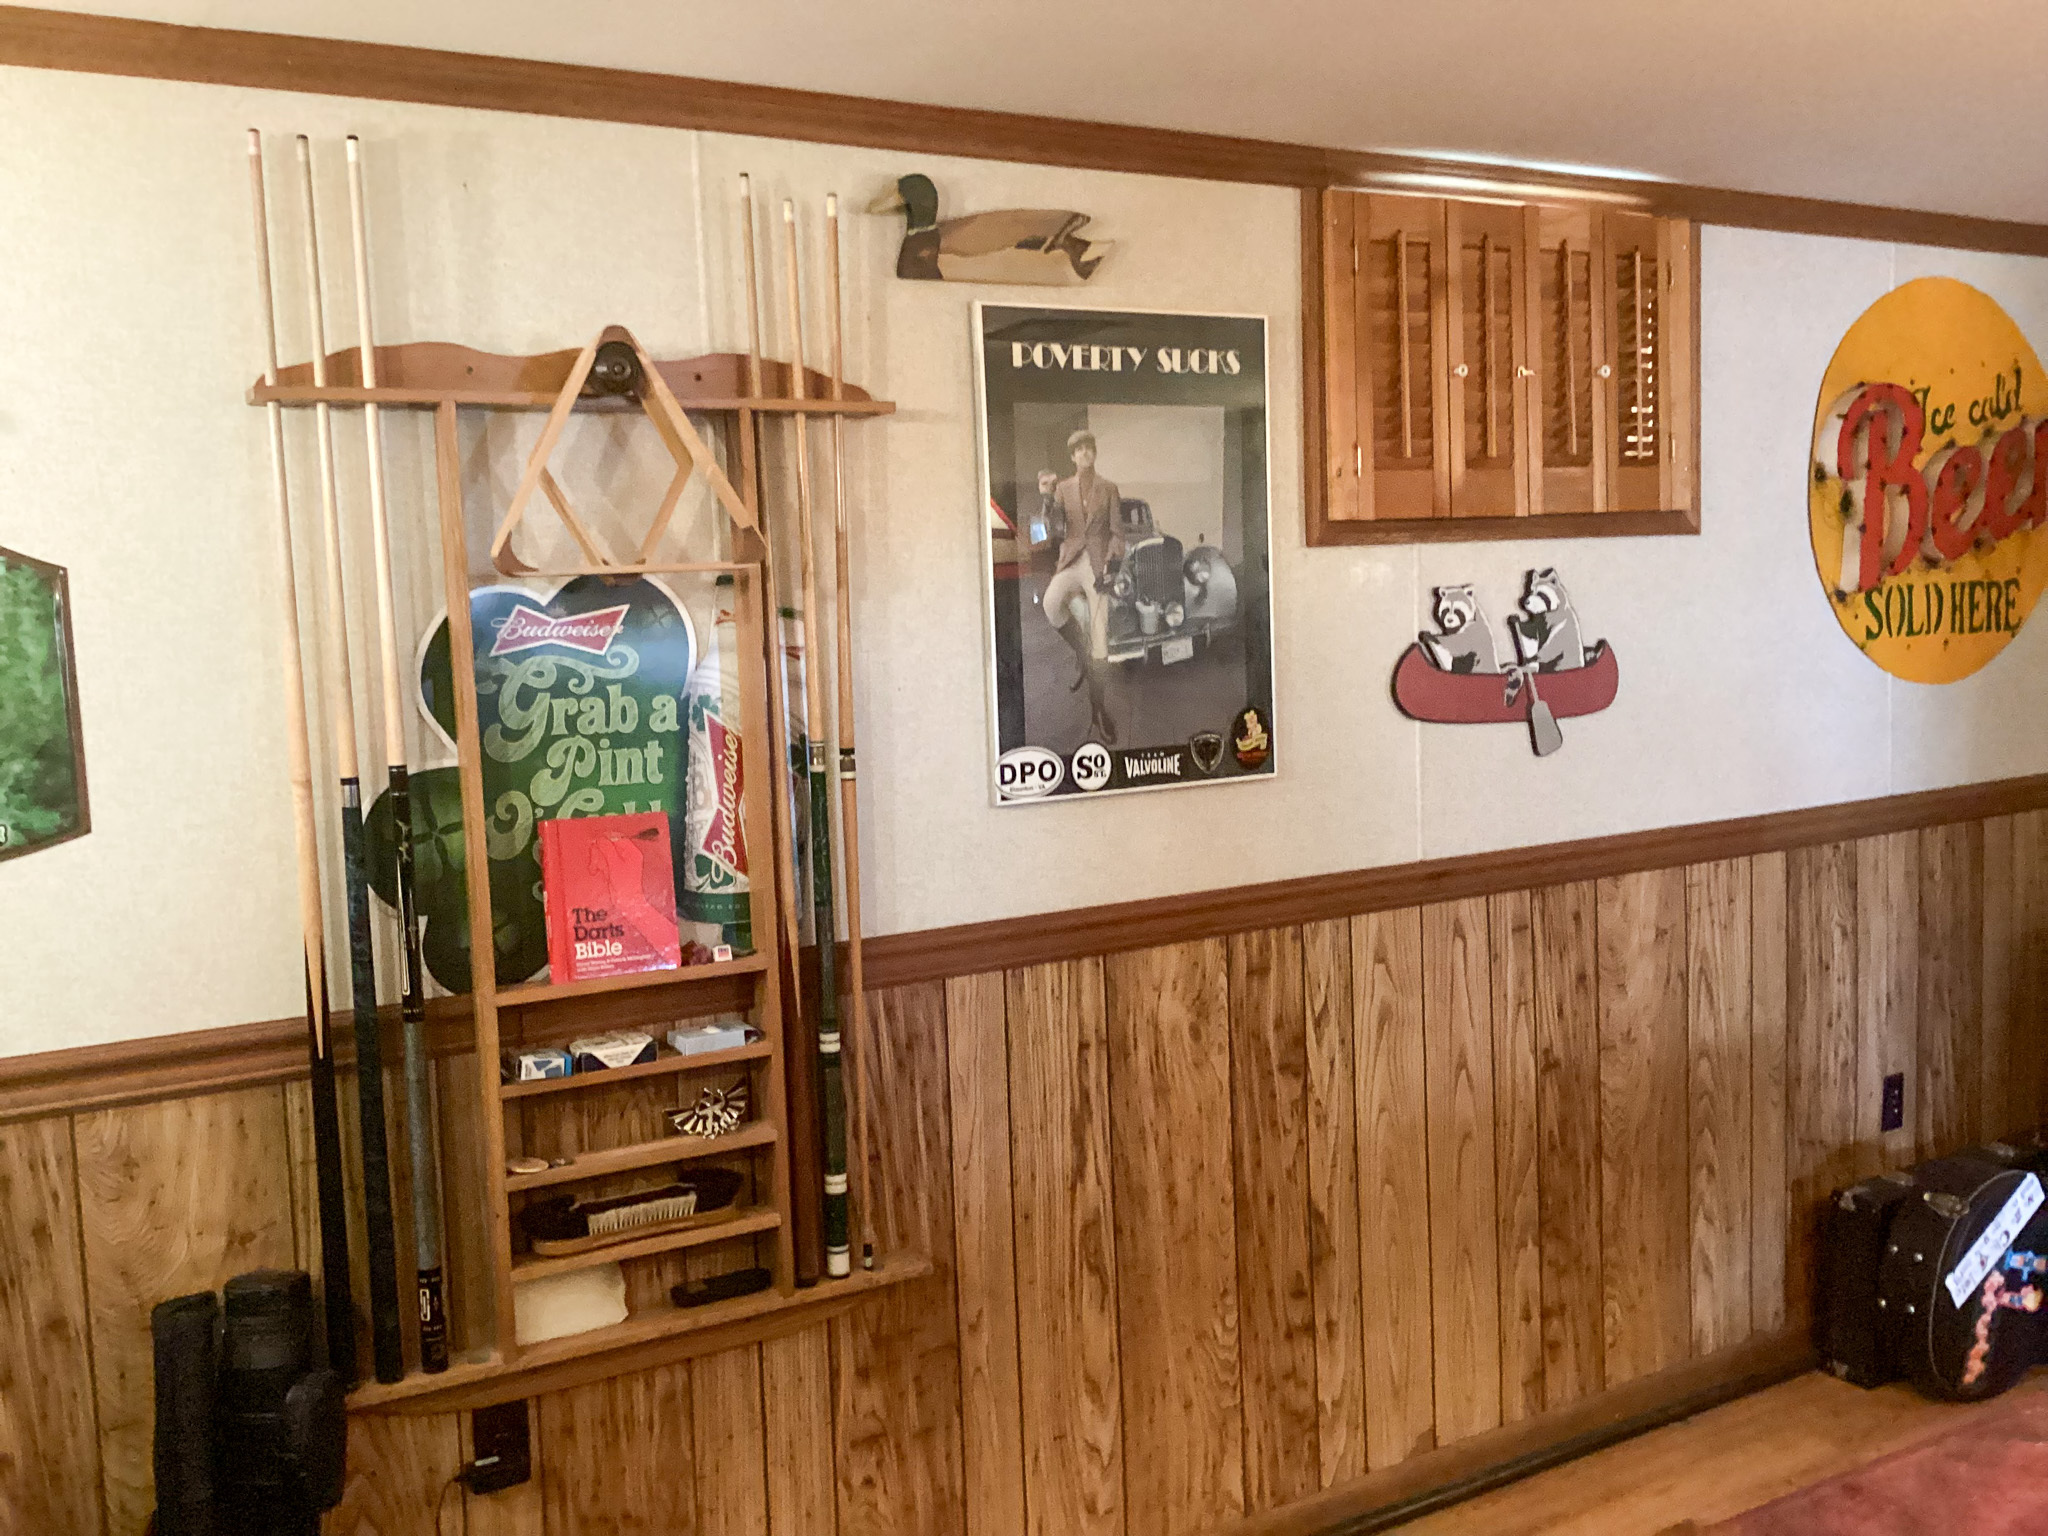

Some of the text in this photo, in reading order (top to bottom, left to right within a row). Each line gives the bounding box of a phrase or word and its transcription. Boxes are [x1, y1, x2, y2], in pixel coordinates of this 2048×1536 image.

[1011, 341, 1241, 375] POVERTY SUCKS
[1912, 366, 2022, 436] Ice cold
[1864, 578, 2023, 641] SOLD HERE
[490, 616, 625, 641] Budweiser
[483, 646, 681, 763] Grab a
[529, 735, 665, 807] Pint
[999, 760, 1057, 786] DPO
[1124, 753, 1181, 779] VALVOLINE
[711, 727, 740, 884] Budweise
[572, 908, 608, 924] The
[573, 923, 625, 942] Darts
[574, 939, 623, 960] Bible
